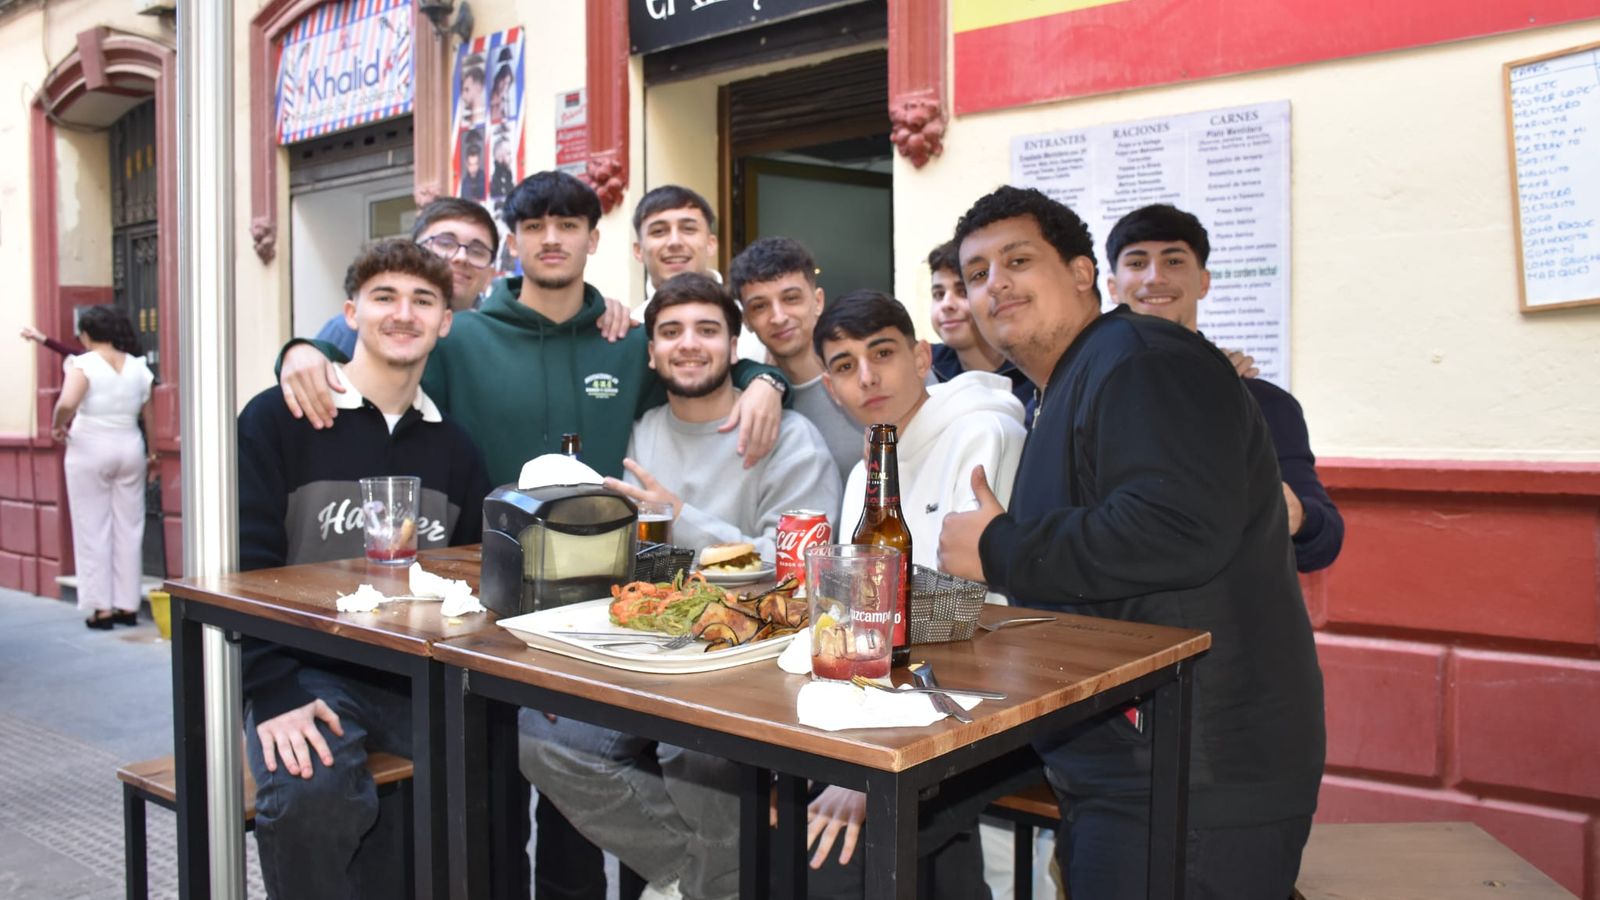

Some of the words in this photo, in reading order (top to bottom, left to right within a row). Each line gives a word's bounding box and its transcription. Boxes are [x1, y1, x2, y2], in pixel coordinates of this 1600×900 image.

[307, 48, 380, 104] Khalid
[1210, 111, 1259, 126] CARNES
[1112, 123, 1170, 139] RACIONES
[1023, 134, 1087, 151] ENTRANTES
